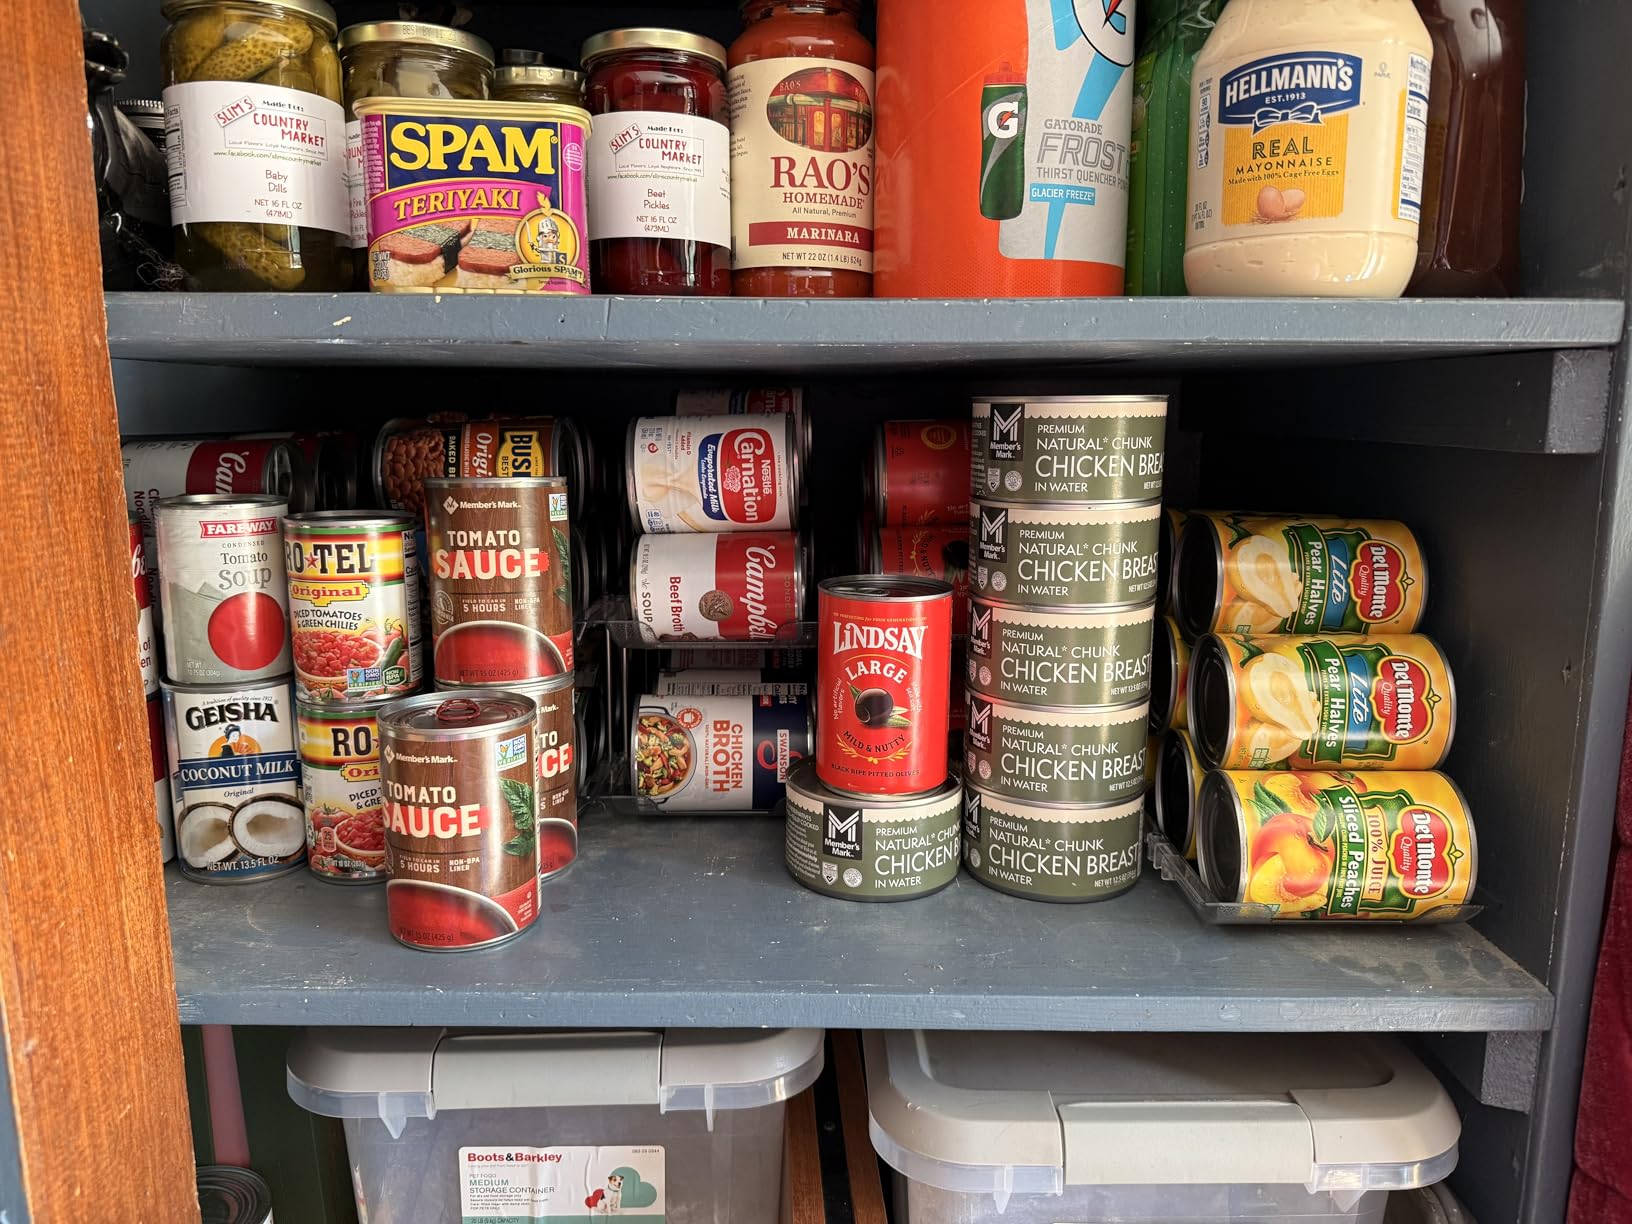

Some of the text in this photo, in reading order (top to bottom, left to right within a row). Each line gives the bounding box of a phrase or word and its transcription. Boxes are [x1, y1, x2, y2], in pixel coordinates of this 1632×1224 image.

[1226, 58, 1354, 108] HELLMANN'S
[217, 98, 253, 124] SLIM'S
[254, 113, 308, 131] COUNTRY
[1044, 119, 1103, 135] GATORADE
[281, 129, 325, 147] MARKET
[610, 126, 640, 150] SLIM'S
[638, 138, 687, 151] COUNTRY
[662, 150, 702, 165] MARKET
[1036, 132, 1126, 174] FROST
[1252, 137, 1314, 160] REAL
[1236, 157, 1332, 175] MAYONNAISE
[266, 170, 288, 183] Baby
[770, 156, 870, 196] RAO'S
[1036, 167, 1074, 179] THIRST
[1077, 169, 1116, 188] QUENCHER
[1228, 169, 1339, 186] Made with 100% Cage Free Eggs
[268, 182, 288, 194] Dills
[648, 188, 666, 198] Beet
[1032, 188, 1064, 198] GLACIER
[394, 188, 520, 222] TERIYAKI
[644, 200, 670, 210] Pickles
[783, 192, 864, 210] HOMEMADE
[792, 206, 856, 219] All Natural, Premium
[786, 227, 860, 244] MARINARA
[782, 252, 795, 260] NET
[797, 252, 807, 260] WT
[809, 252, 817, 261] 22
[819, 252, 827, 262] OZ
[514, 265, 552, 274] Glorious
[1038, 425, 1085, 434] PREMIUM
[448, 435, 456, 464] BAKED
[990, 441, 1021, 450] Member's
[1112, 437, 1152, 449] CHUNK
[1035, 455, 1134, 478] CHICKEN
[706, 444, 720, 513] Evaporated Milk
[734, 431, 766, 521] Carnation
[1035, 482, 1088, 492] IN WATER
[460, 500, 521, 509] Member's Mark
[207, 521, 275, 534] FAREWAY
[1019, 530, 1065, 539] PREMIUM
[447, 530, 520, 547] TOMATO
[979, 543, 1005, 553] Member's
[1092, 541, 1138, 555] CHUNK
[1308, 541, 1322, 573] Pear
[220, 552, 268, 565] Tomato
[435, 548, 541, 579] SAUCE
[1018, 552, 1158, 582] CHICKEN BREAS
[219, 566, 272, 590] Soup
[1331, 554, 1348, 605] Lite
[1359, 564, 1369, 596] Quality
[292, 586, 362, 599] Original
[740, 546, 777, 640] Campbell
[1017, 584, 1069, 596] IN WATER
[464, 604, 506, 612] 5 HOURS
[642, 592, 653, 622] SOUP
[670, 576, 685, 632] Beef Broth
[1304, 579, 1325, 625] Halves
[294, 610, 362, 622] DICED TOMATOES
[302, 619, 323, 628] GREEN
[325, 620, 358, 631] CHILIES
[833, 621, 928, 660] LINDSAY
[1003, 628, 1044, 641] PREMIUM
[1072, 645, 1120, 659] CHUNK
[845, 660, 908, 684] LARGE
[1001, 653, 1151, 684] CHICKEN BREAST
[1325, 658, 1341, 692] Pear
[1000, 681, 1048, 696] IN WATER
[1350, 672, 1369, 725] Lite
[1382, 682, 1393, 715] Quality
[185, 702, 279, 732] GEISHA
[1326, 698, 1345, 748] Halves
[843, 730, 864, 749] MILD
[875, 734, 905, 752] NUTTY
[1071, 742, 1119, 756] CHUNK
[396, 753, 457, 764] Member's Mark
[713, 720, 730, 792] BROTH
[731, 724, 743, 788] CHICKEN
[181, 760, 294, 782] COCONUT MILK
[1001, 753, 1097, 781] CHICKEN
[224, 788, 254, 798] Original
[349, 789, 377, 802] DICED
[387, 780, 456, 803] TOMATO
[383, 796, 481, 839] SAUCE
[990, 816, 1028, 832] PREMIUM
[1339, 796, 1364, 843] Sliced
[876, 826, 918, 836] PREMIUM
[825, 837, 860, 851] Member's
[1054, 839, 1104, 852] CHUNK
[875, 844, 953, 875] CHICKEN
[989, 842, 1138, 876] CHICKEN BREAST
[1368, 814, 1386, 894] 100% JUICE
[1401, 836, 1412, 872] Quality
[207, 862, 222, 870] NET
[223, 860, 238, 870] WT.
[240, 858, 256, 869] 13.5
[257, 857, 267, 866] FL
[401, 860, 440, 873] 5 HOURS
[875, 877, 921, 888] IN WATER
[989, 866, 1032, 886] IN WATER
[1341, 851, 1364, 908] Peaches
[468, 1152, 562, 1163] Boots&Barkley
[509, 1186, 555, 1195] CONTAINER
